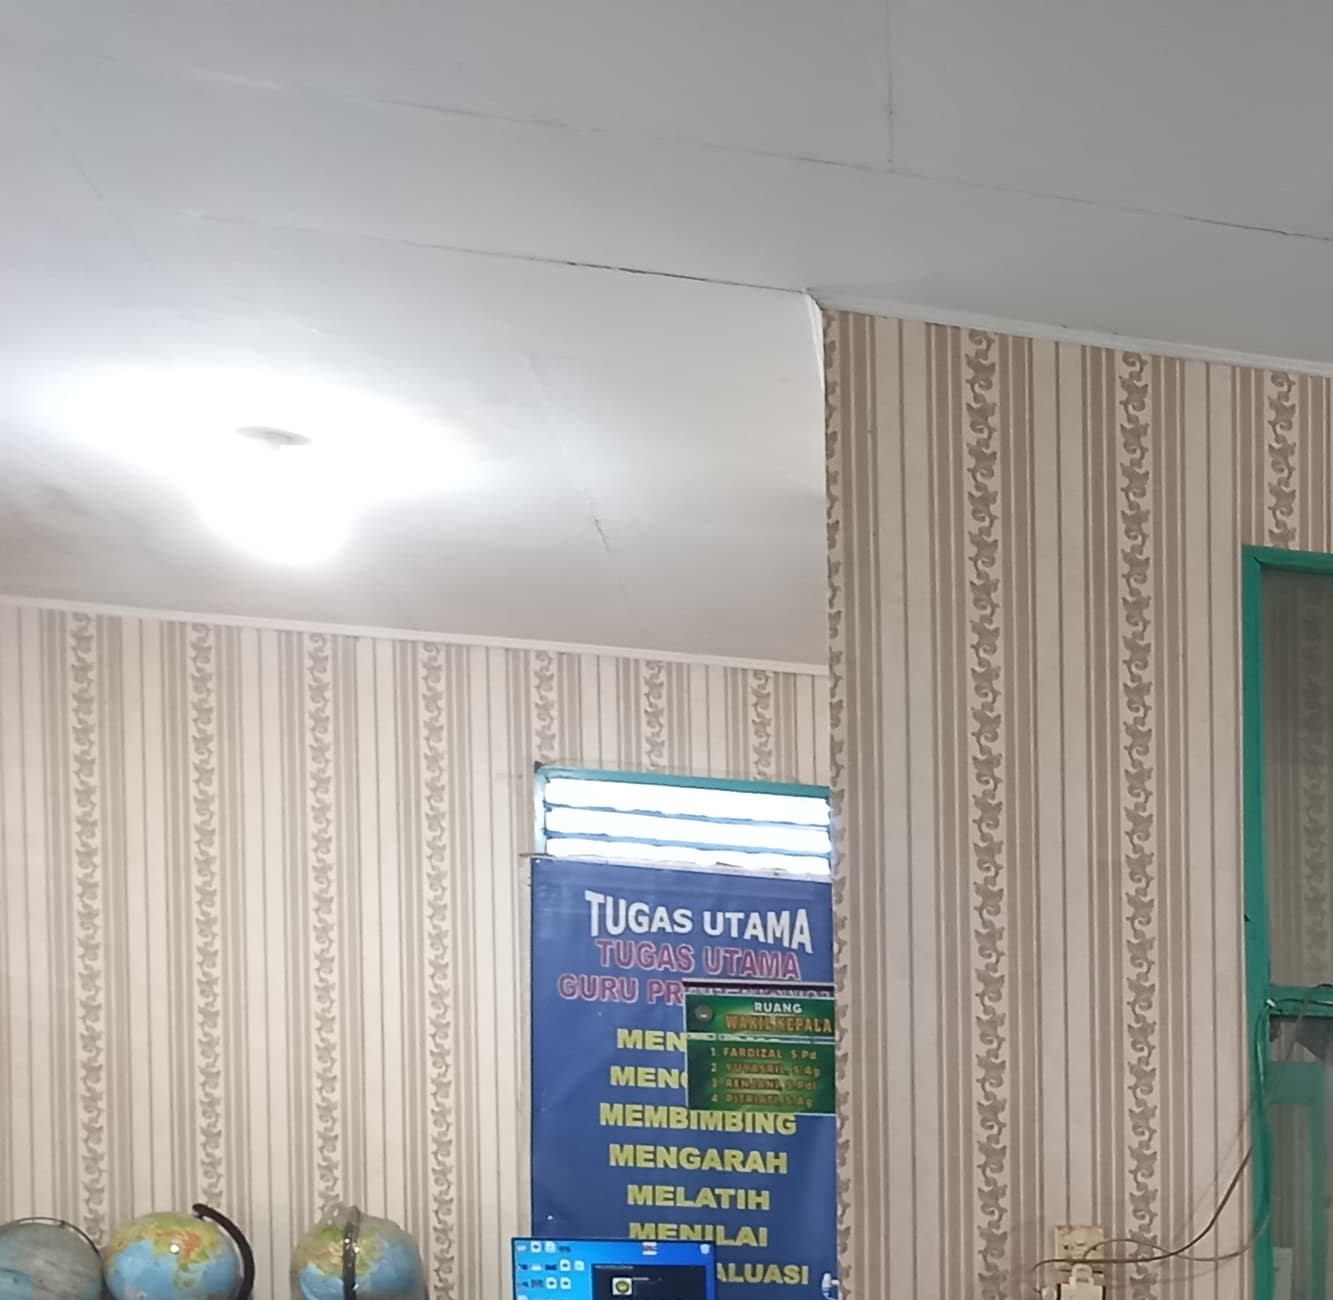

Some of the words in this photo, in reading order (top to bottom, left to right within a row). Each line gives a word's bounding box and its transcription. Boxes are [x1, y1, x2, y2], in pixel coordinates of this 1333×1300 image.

[584, 890, 693, 937] TUGAS
[703, 908, 813, 954] UTAMA
[595, 939, 695, 974] TUGAS
[702, 946, 801, 981] UTAMA
[557, 973, 639, 1004] GURU
[753, 1001, 803, 1014] RUANG
[600, 1102, 797, 1136] MEMBIMBING
[608, 1144, 788, 1175] MENGARAH
[627, 1184, 771, 1211] MELATIH
[628, 1222, 769, 1248] MENILAI
